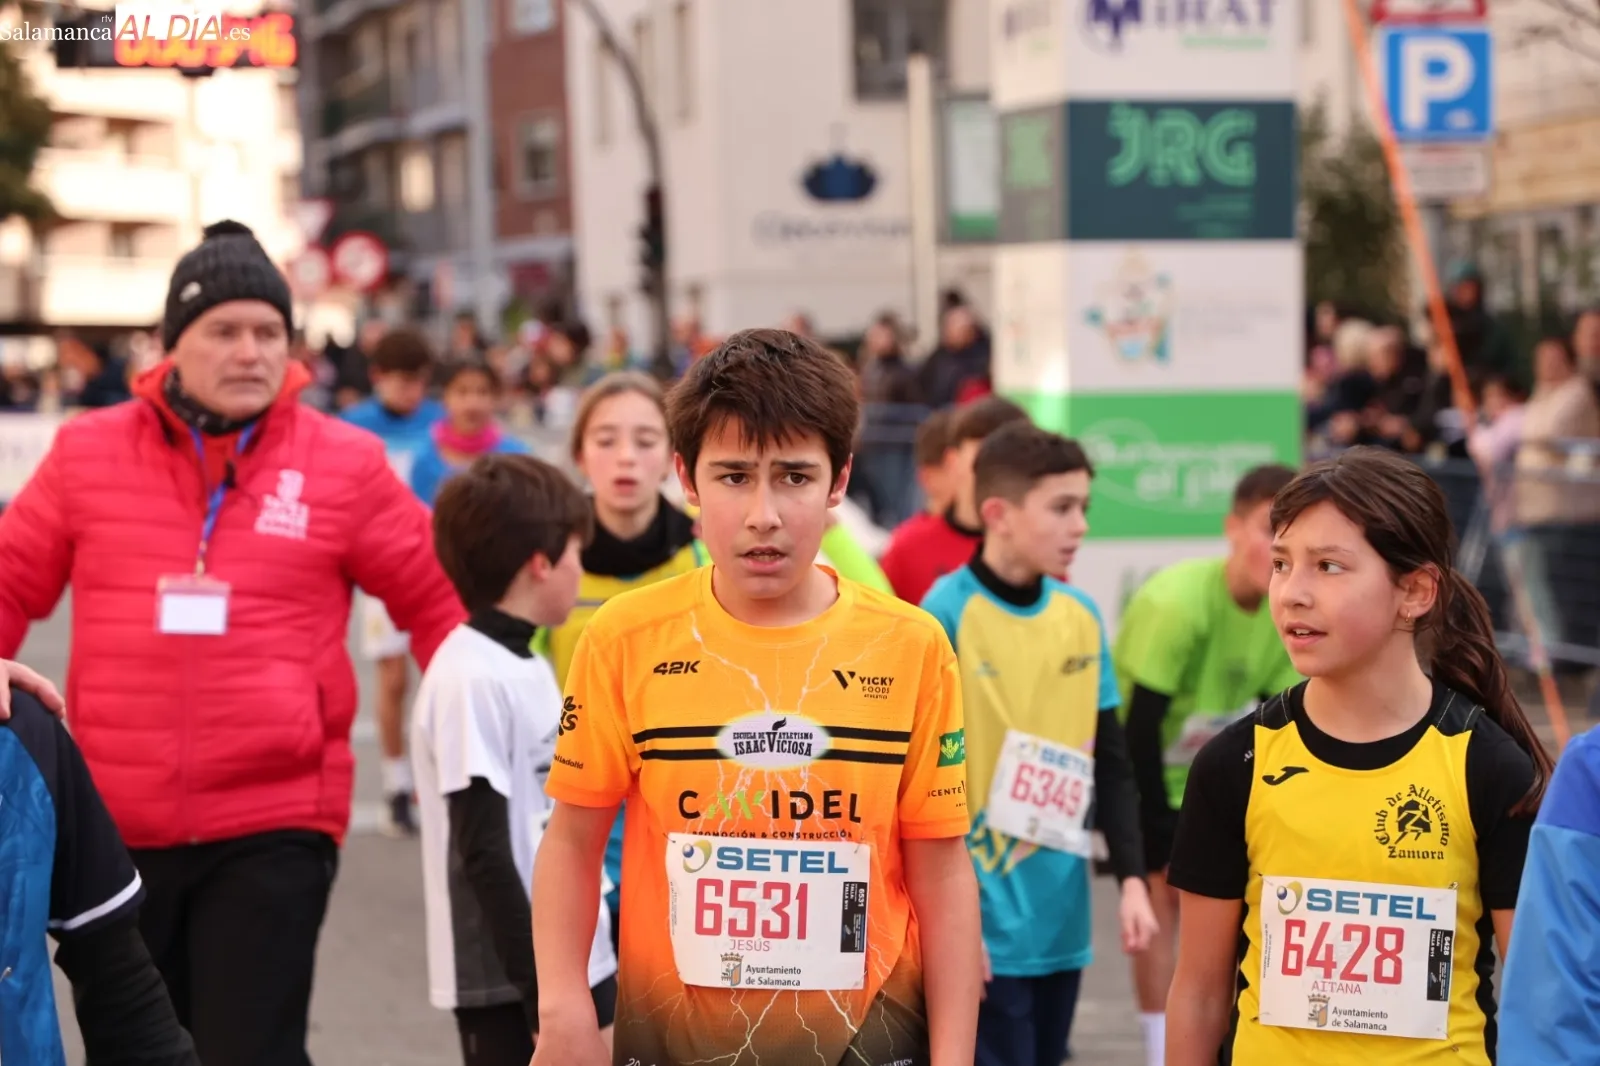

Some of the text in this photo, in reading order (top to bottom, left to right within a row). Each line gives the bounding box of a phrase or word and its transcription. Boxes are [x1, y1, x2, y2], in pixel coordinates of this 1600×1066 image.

[1402, 35, 1474, 130] P
[1106, 101, 1256, 187] JRG
[653, 660, 700, 675] 42K
[859, 676, 894, 686] VICKY
[862, 685, 890, 694] FOODS
[732, 732, 813, 740] ESCUELA DE ATLETISMO
[733, 731, 812, 757] ISAAC VICIOSA
[553, 753, 584, 770] alladolid
[1010, 762, 1083, 818] 6349
[1374, 784, 1450, 847] Club de Atletismo
[716, 846, 849, 874] SETEL
[1388, 845, 1444, 860] Zamora
[695, 878, 808, 940] 6531
[1306, 888, 1437, 921] SETEL
[729, 938, 770, 952] JESÚS
[1281, 919, 1405, 985] 6428
[1443, 936, 1451, 956] 6428
[745, 964, 801, 975] Ayuntamiento
[745, 976, 801, 987] de Salamanca
[1311, 980, 1362, 995] AITANA
[1332, 1006, 1389, 1019] Ayuntamiento
[1331, 1019, 1388, 1031] de Salamanca
